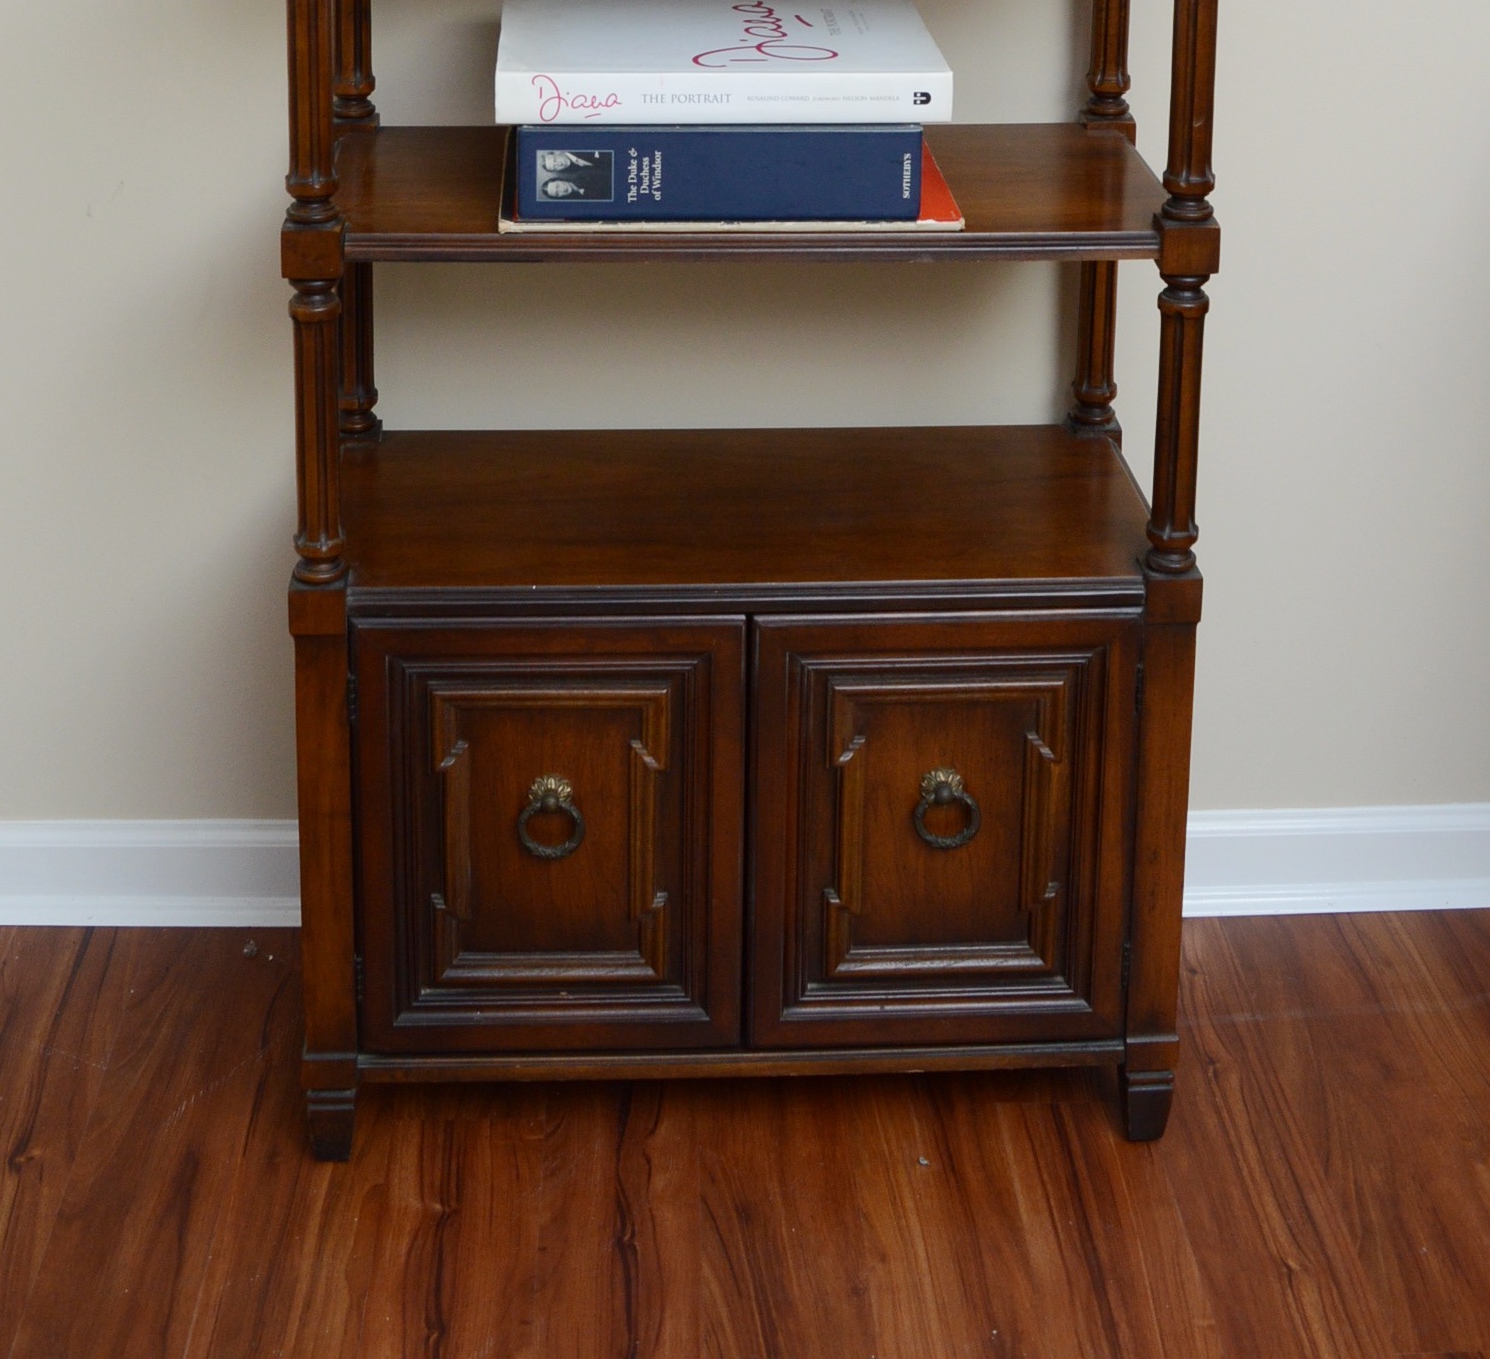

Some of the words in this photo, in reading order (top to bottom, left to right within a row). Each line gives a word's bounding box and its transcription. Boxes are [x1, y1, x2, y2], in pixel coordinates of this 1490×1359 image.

[531, 74, 623, 122] Diana
[641, 93, 667, 104] THE
[671, 93, 732, 104] PORTRAIT
[628, 147, 638, 157] &
[627, 158, 638, 184] Duke
[640, 156, 650, 194] Duchess
[651, 150, 662, 187] Windsor
[627, 187, 638, 203] The
[652, 189, 662, 201] of
